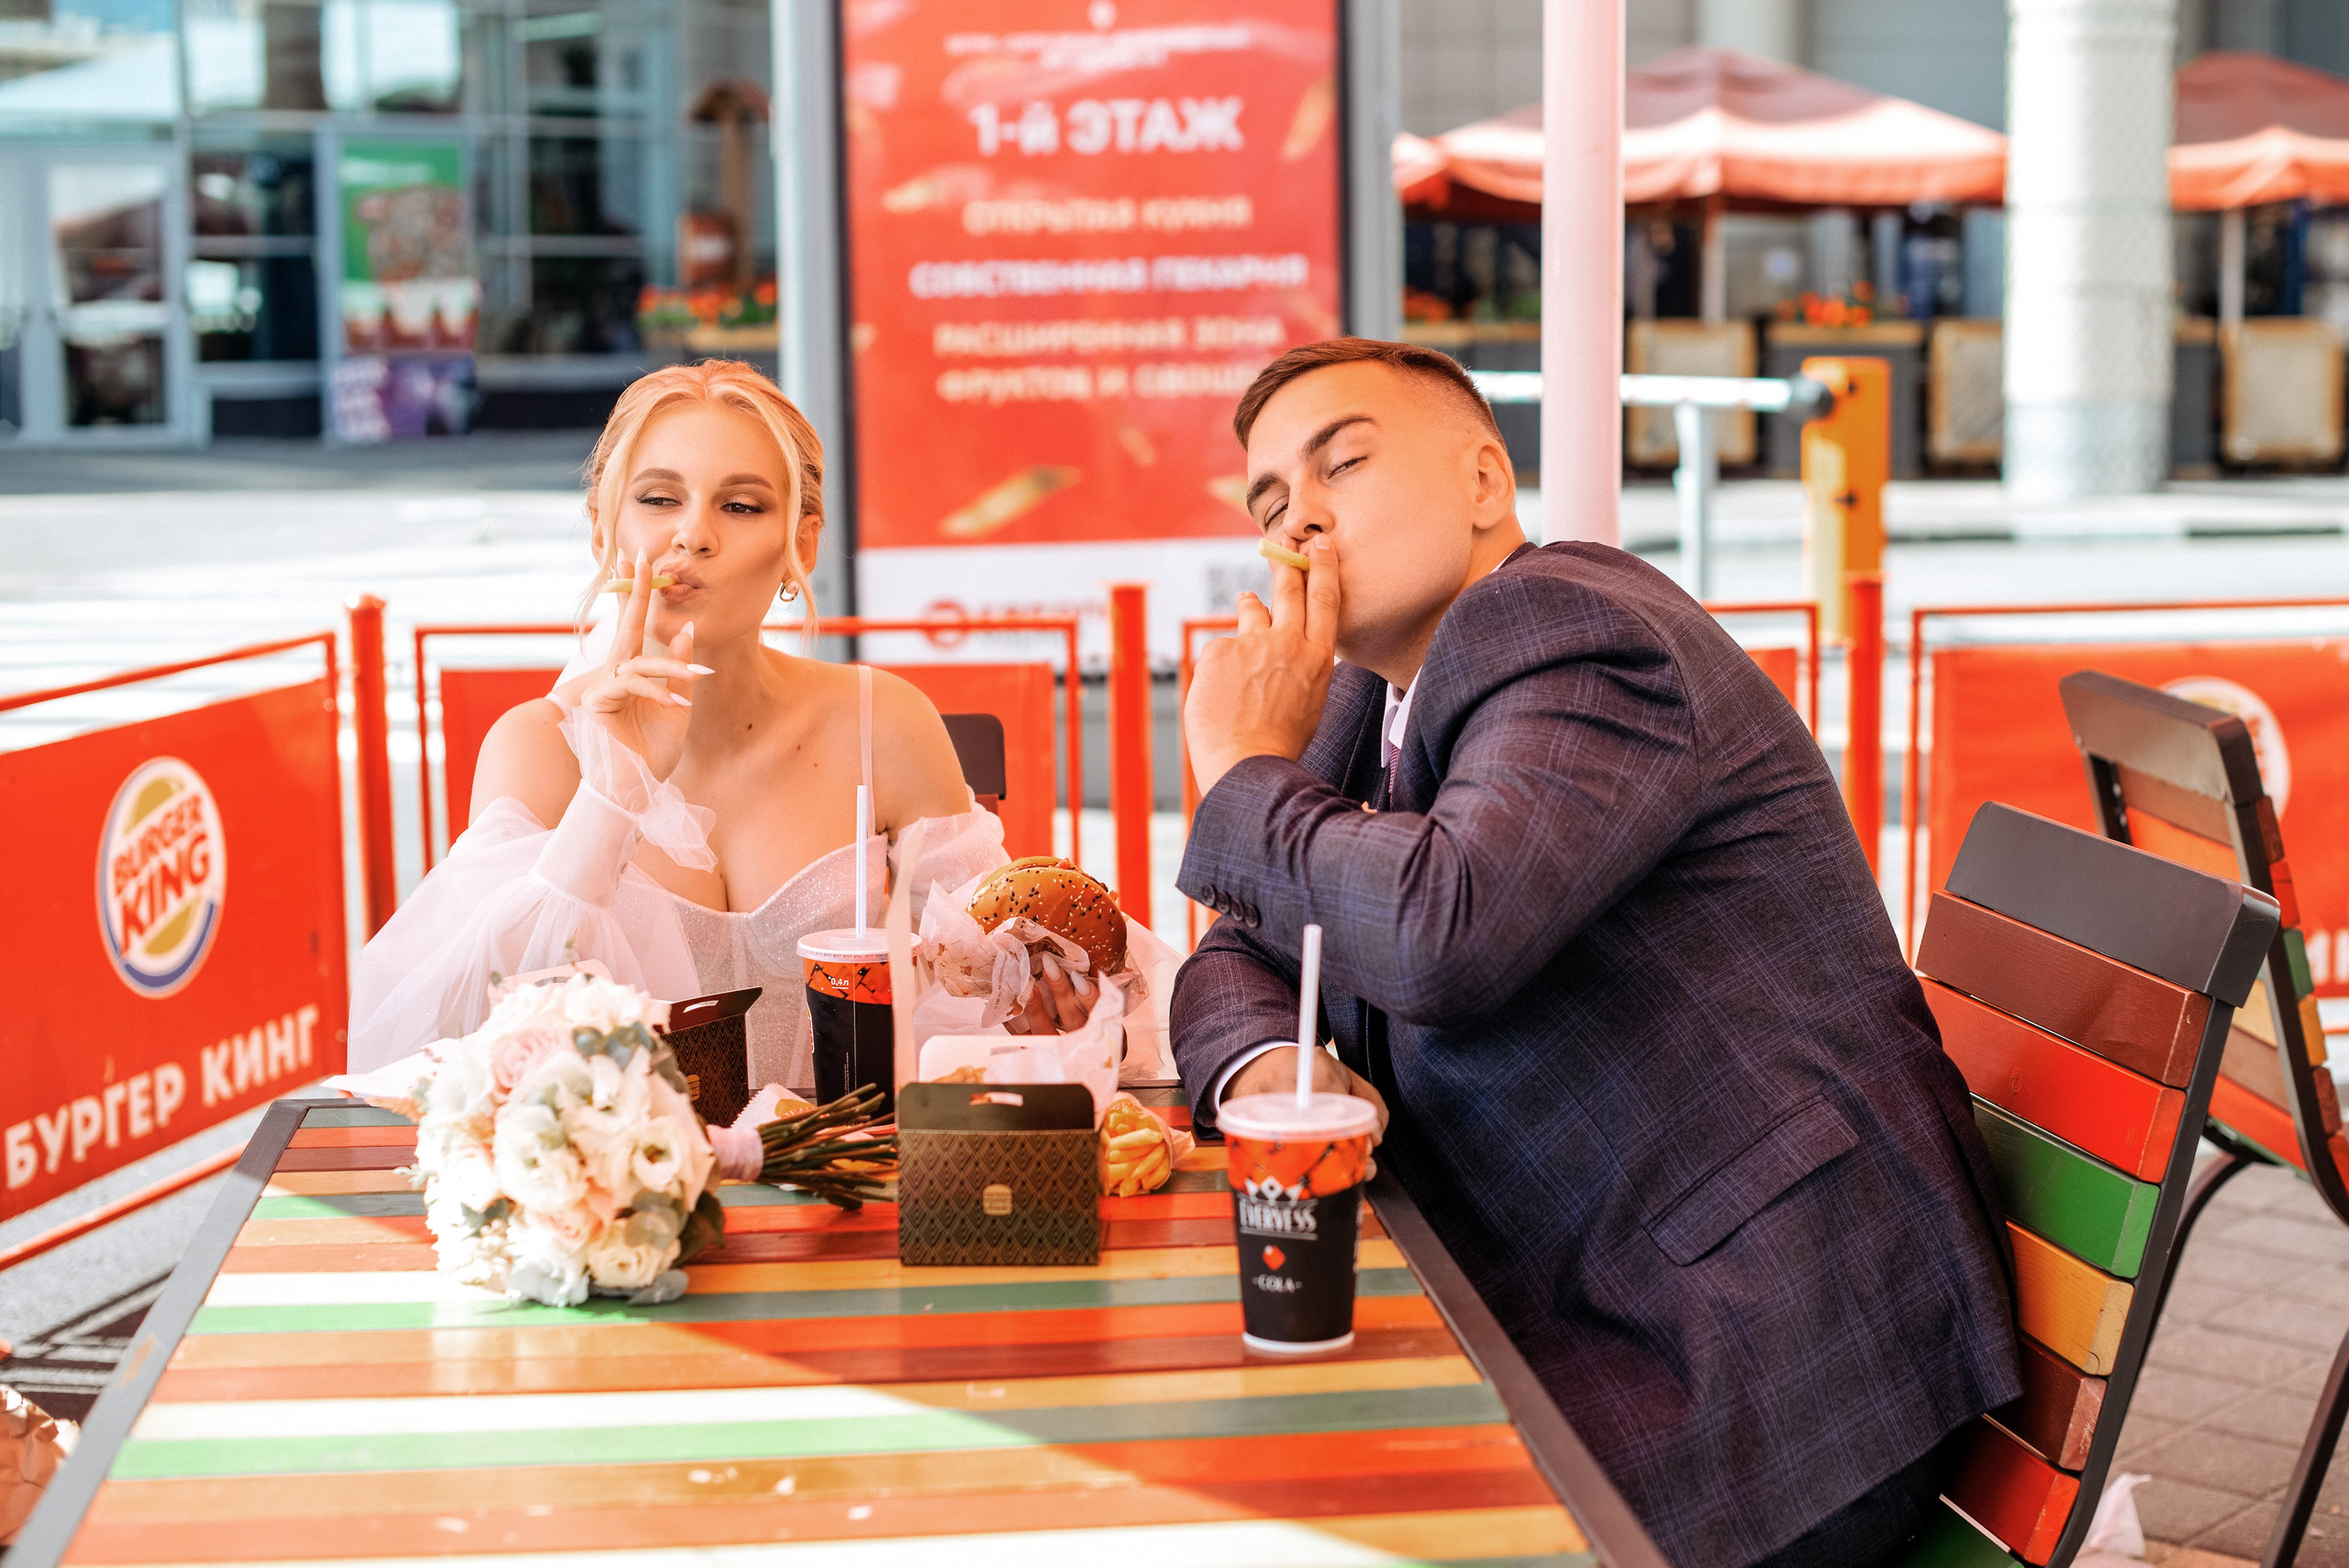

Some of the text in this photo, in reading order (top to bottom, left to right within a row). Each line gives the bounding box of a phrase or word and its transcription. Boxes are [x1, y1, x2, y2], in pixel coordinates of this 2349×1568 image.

[1067, 97, 1244, 154] ЭТАЖ
[963, 195, 1252, 237] ОТКРЫТАЯ КУХНЯ
[908, 252, 1308, 298] СОБСТВЕННАЯ ПЕКАРНЯ
[1195, 317, 1282, 352] ЗОНА
[112, 793, 204, 897] BURGER
[120, 834, 211, 955] KING
[5, 1003, 320, 1189] БУРГЕР КИНГ
